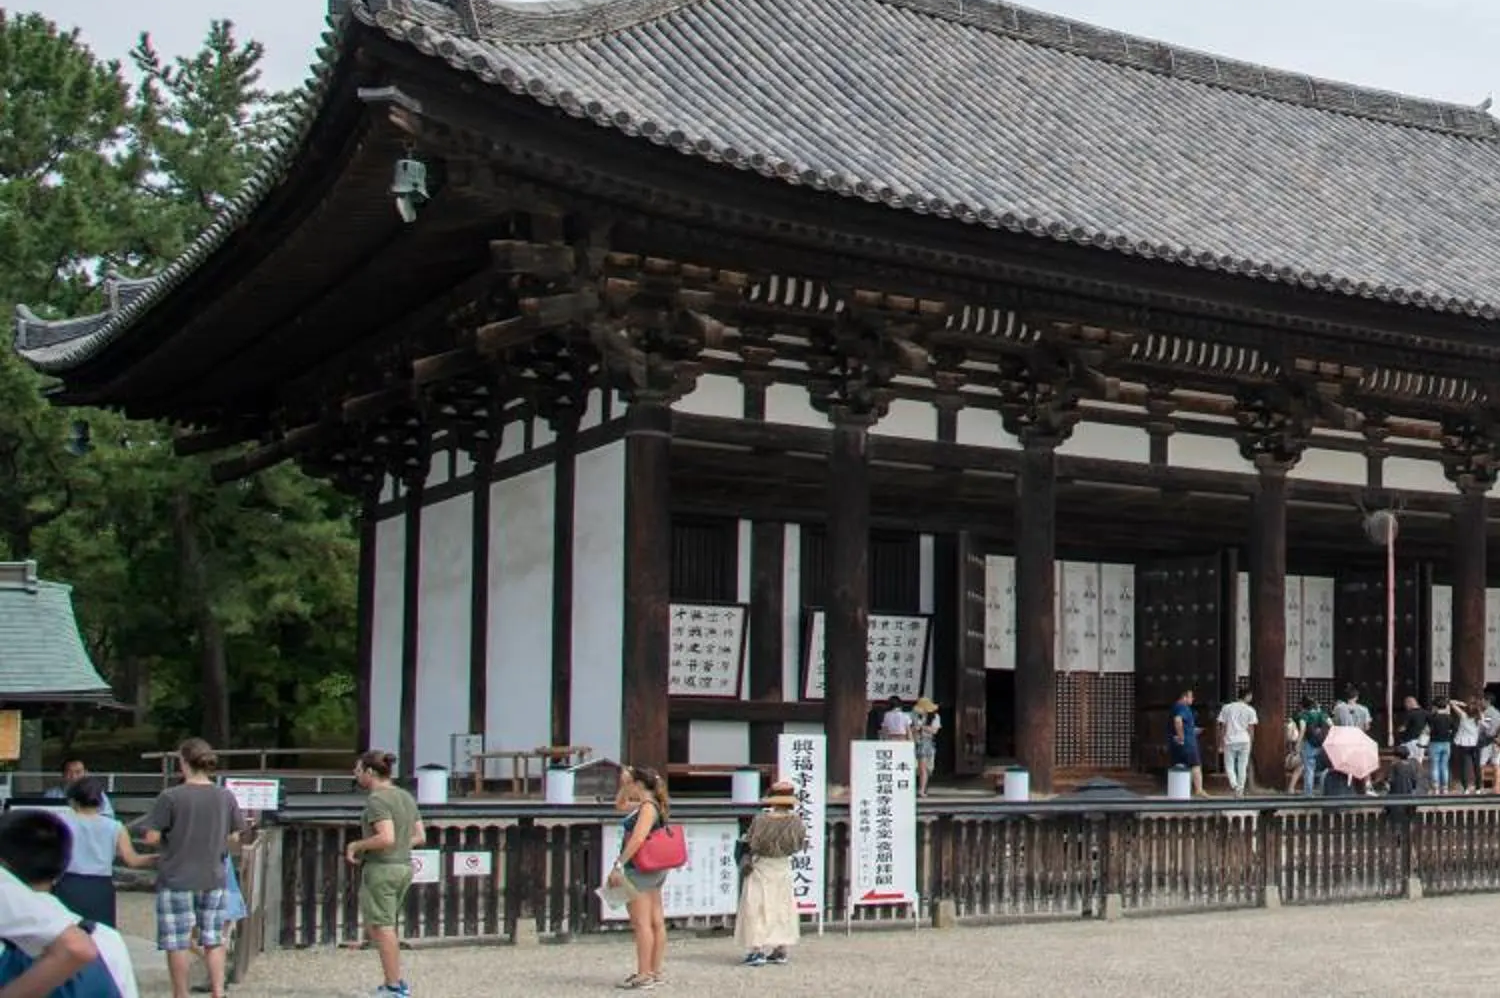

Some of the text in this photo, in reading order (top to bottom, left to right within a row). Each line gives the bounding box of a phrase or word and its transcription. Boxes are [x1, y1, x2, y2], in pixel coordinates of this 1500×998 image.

[791, 739, 814, 897] 興福寺東金観入口
[896, 762, 911, 789] 本日
